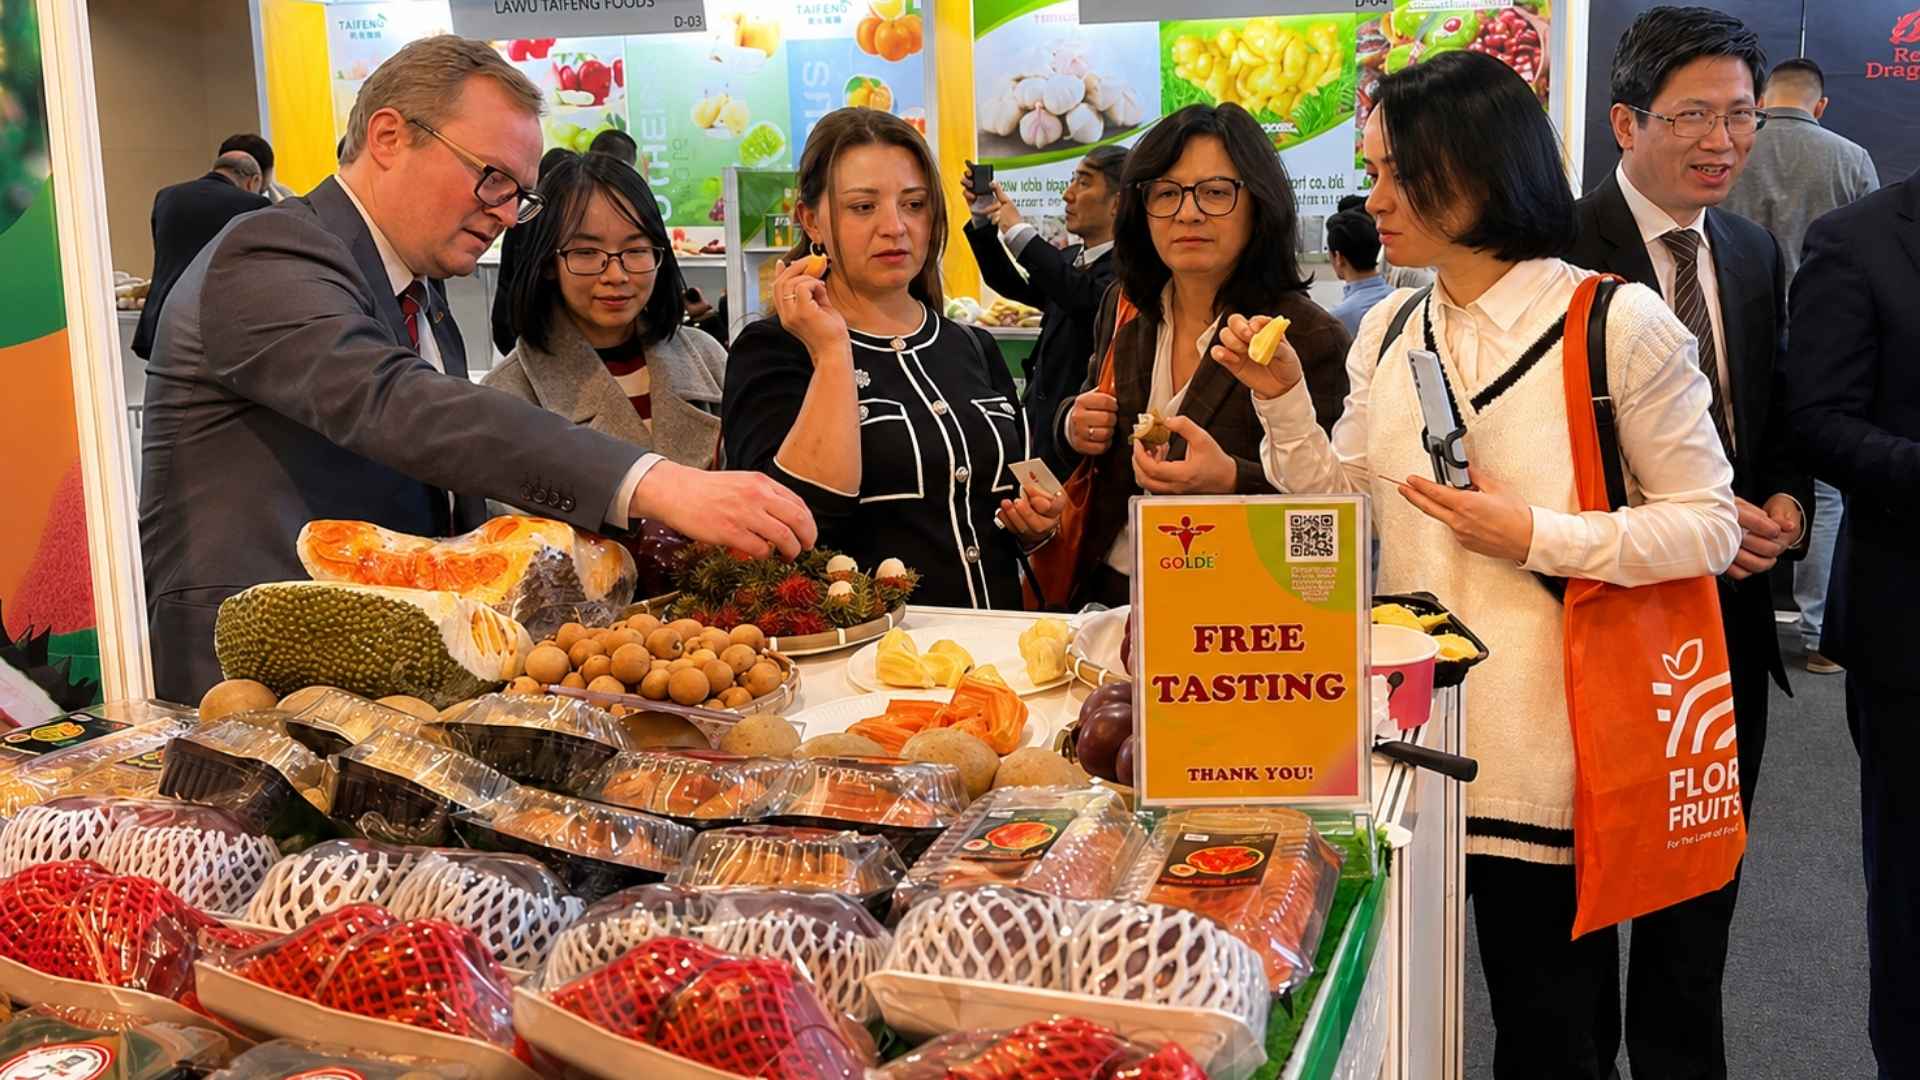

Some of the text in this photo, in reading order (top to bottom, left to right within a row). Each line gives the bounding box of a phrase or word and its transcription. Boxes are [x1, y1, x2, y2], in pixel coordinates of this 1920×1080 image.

[494, 0, 655, 14] LAWU TAIFENG FOODS
[674, 16, 702, 28] D-03
[1192, 623, 1305, 654] FREE
[1152, 673, 1346, 703] TASTING
[1187, 766, 1314, 782] THANK YOU!
[1669, 757, 1740, 802] FLOR
[1668, 792, 1740, 832] FRUITS
[1667, 840, 1680, 849] For
[1680, 836, 1695, 845] The
